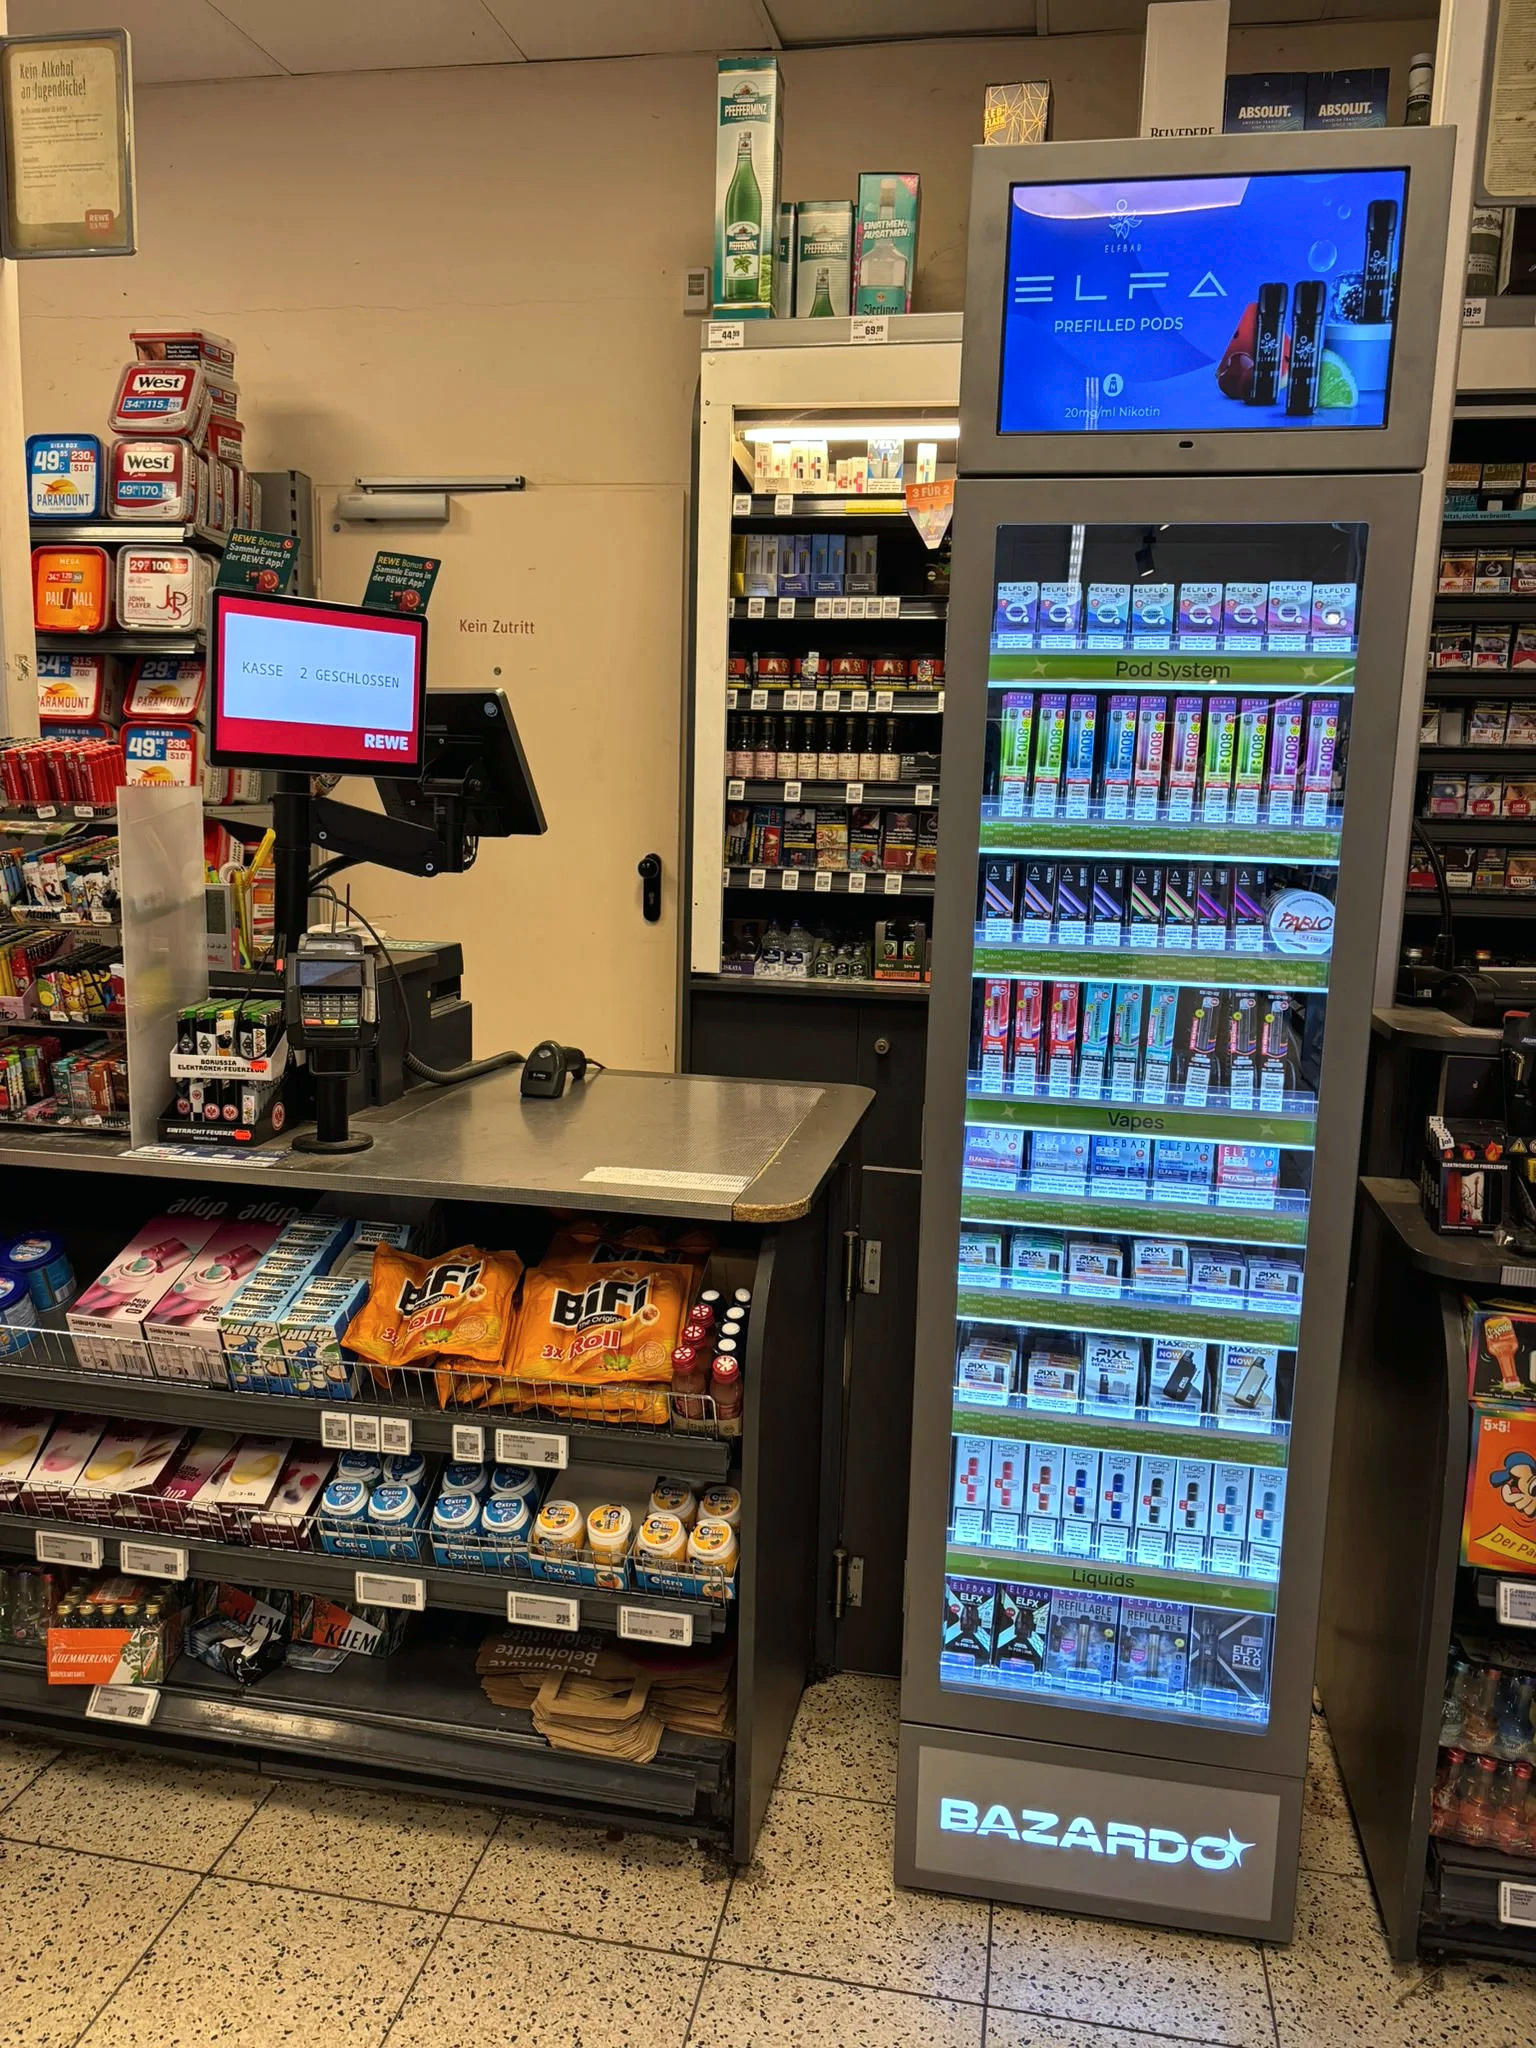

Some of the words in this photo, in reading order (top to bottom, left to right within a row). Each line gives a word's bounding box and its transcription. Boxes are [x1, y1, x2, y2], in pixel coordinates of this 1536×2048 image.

[19, 63, 38, 79] Kein
[41, 59, 74, 78] Alkohol
[21, 86, 30, 99] an
[724, 103, 767, 117] PFEFFERMINZ
[1239, 104, 1291, 119] ABSOLUT.
[1318, 102, 1373, 117] ABSOLUT.
[1150, 126, 1215, 138] BELVEDERE
[1014, 271, 1228, 303] ELFA
[1053, 318, 1136, 334] PREFILLED
[1140, 317, 1184, 332] PODS
[138, 376, 180, 389] West
[1064, 405, 1117, 420] 20mg/ml
[1118, 405, 1161, 418] Nikotin
[128, 455, 172, 469] West
[912, 488, 920, 498] 3
[921, 484, 940, 498] FÜR
[941, 485, 951, 496] 2
[37, 493, 90, 507] PARAMOUNT
[232, 533, 257, 545] REWE
[258, 537, 281, 549] Bonus
[229, 543, 259, 554] Sammle
[261, 548, 283, 558] Euros
[226, 552, 240, 561] der
[240, 554, 265, 566] REWE
[265, 558, 284, 569] App!
[378, 556, 401, 567] REWE
[401, 559, 423, 570] Bonus
[375, 565, 403, 575] Sammle
[404, 570, 424, 579] Euros
[425, 572, 432, 580] in
[372, 573, 384, 583] der
[385, 575, 408, 587] REWE
[408, 579, 425, 589] App!
[1520, 579, 1536, 587] Wes
[45, 590, 64, 607] PALL
[71, 591, 94, 607] MALL
[459, 618, 488, 634] Kein
[492, 620, 535, 635] Zutritt
[242, 661, 284, 677] KASSE
[300, 667, 308, 680] 2
[315, 668, 400, 689] GESCHLOSSEN
[1115, 660, 1153, 677] Pod
[1157, 661, 1231, 679] System
[136, 696, 192, 707] PARAMOUNT
[364, 733, 409, 751] REWE
[1016, 727, 1029, 752] 800
[1049, 729, 1063, 753] 800
[1080, 729, 1093, 754] 800
[1121, 730, 1133, 754] 800
[1150, 732, 1162, 756] 800
[1185, 733, 1198, 757] 800
[1219, 733, 1233, 758] 800
[1251, 734, 1265, 759] 800
[1285, 735, 1298, 760] 800
[1321, 737, 1333, 762] 800
[1278, 911, 1333, 935] PABLO
[1107, 1111, 1165, 1132] Vapes
[166, 1127, 206, 1135] EINTRACHT
[970, 1128, 1018, 1142] ELFBAR
[1035, 1134, 1086, 1146] ELFBAR
[1096, 1138, 1146, 1149] ELFBAR
[1159, 1141, 1210, 1153] ELFBAR
[1224, 1146, 1275, 1158] ELFBAR
[400, 1260, 484, 1318] BiFi
[553, 1278, 651, 1330] BiFi
[71, 1319, 95, 1328] SHRIMP
[591, 1313, 625, 1326] Original
[226, 1323, 273, 1337] HOLY
[285, 1328, 332, 1342] HOLY
[542, 1344, 562, 1360] 3x
[568, 1328, 621, 1361] Roll
[1095, 1348, 1131, 1360] PIXL
[964, 1439, 986, 1448] HQD
[997, 1444, 1020, 1452] HQD
[1035, 1448, 1057, 1457] HQD
[1070, 1452, 1093, 1461] HQD
[1109, 1455, 1131, 1464] HQD
[1490, 1532, 1517, 1550] Der
[544, 1563, 576, 1576] extra
[1072, 1569, 1135, 1589] Liquids
[953, 1582, 993, 1594] ELFBAR
[1009, 1586, 1049, 1599] ELFBAR
[960, 1592, 983, 1603] ELFX
[1016, 1596, 1039, 1608] ELFX
[1058, 1599, 1112, 1617] REFILLABLE
[1127, 1610, 1183, 1626] REFILLABLE
[51, 1652, 118, 1664] KUEMMERLING
[495, 1644, 598, 1667] Belohntüte
[1232, 1645, 1262, 1657] ELFX
[1232, 1655, 1262, 1667] PRO
[940, 1797, 1237, 1871] BAZARDO
